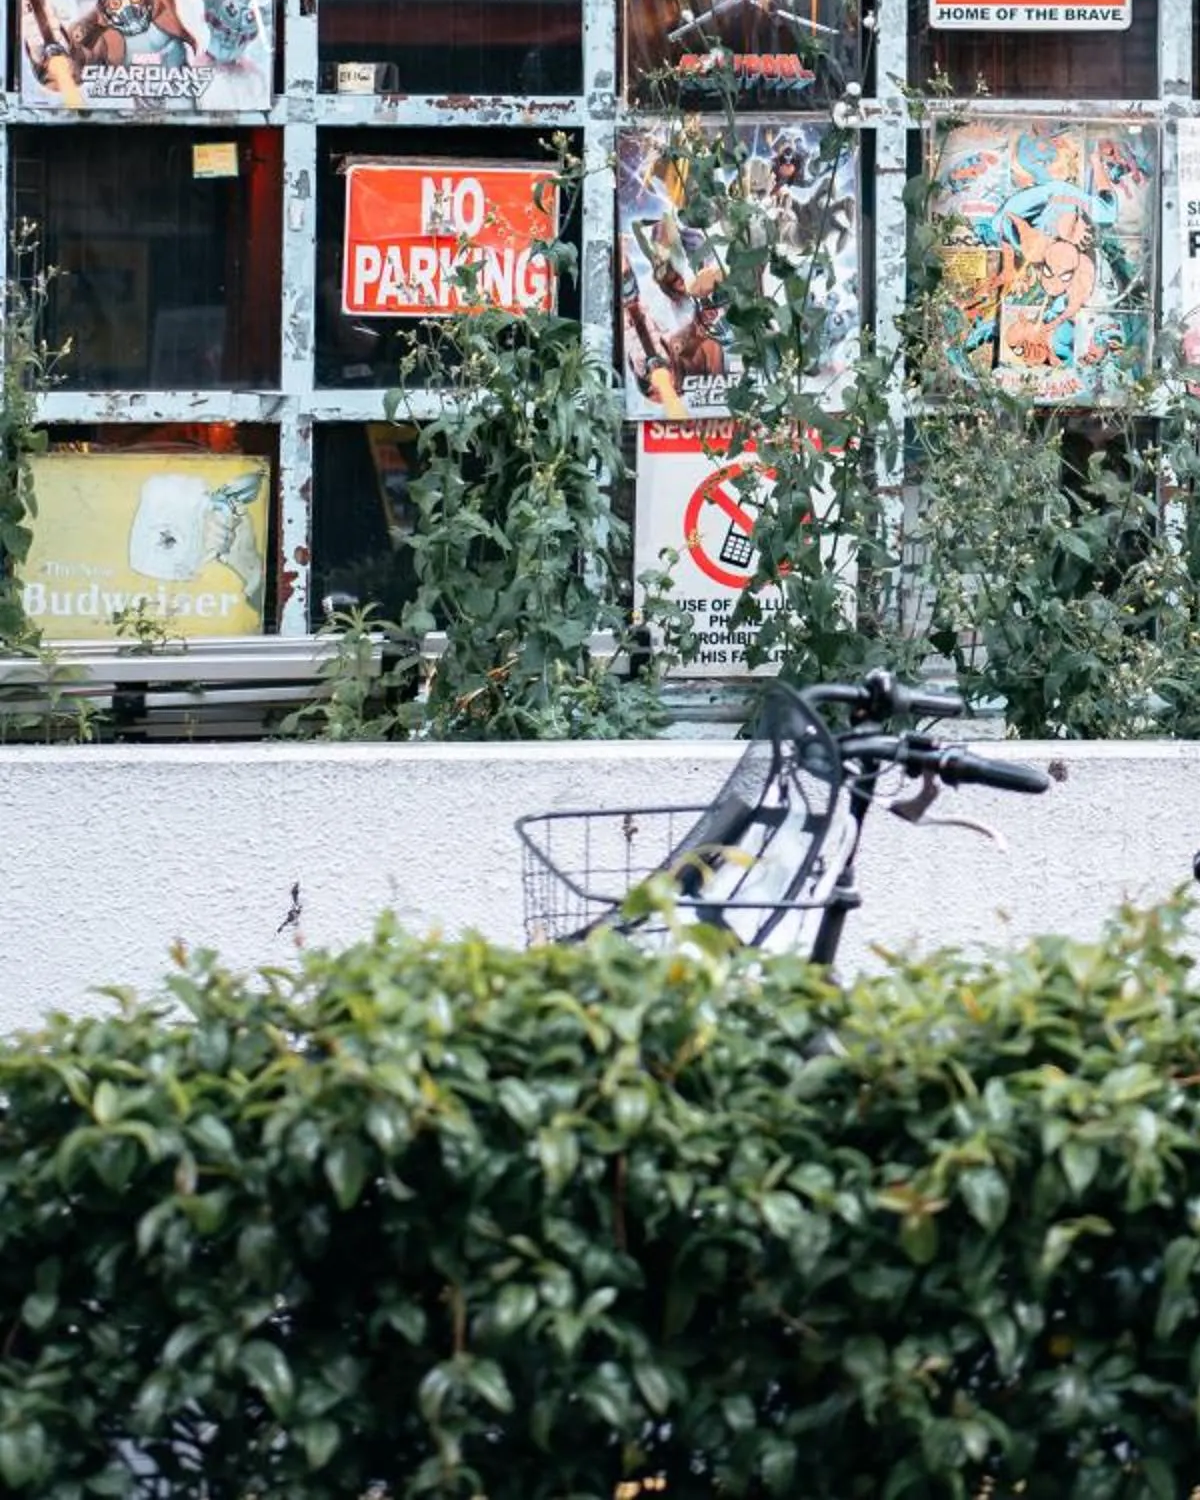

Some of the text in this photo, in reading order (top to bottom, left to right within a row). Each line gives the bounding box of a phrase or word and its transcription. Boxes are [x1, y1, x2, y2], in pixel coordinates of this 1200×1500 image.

[938, 7, 1124, 22] HOME OF THE BRAVE
[81, 65, 214, 82] GUARDIANS
[108, 81, 210, 98] GALAXY
[421, 177, 486, 238] NO
[354, 244, 549, 309] PARKING
[22, 582, 240, 617] Budweiser
[677, 599, 707, 612] USE
[711, 600, 732, 611] OF
